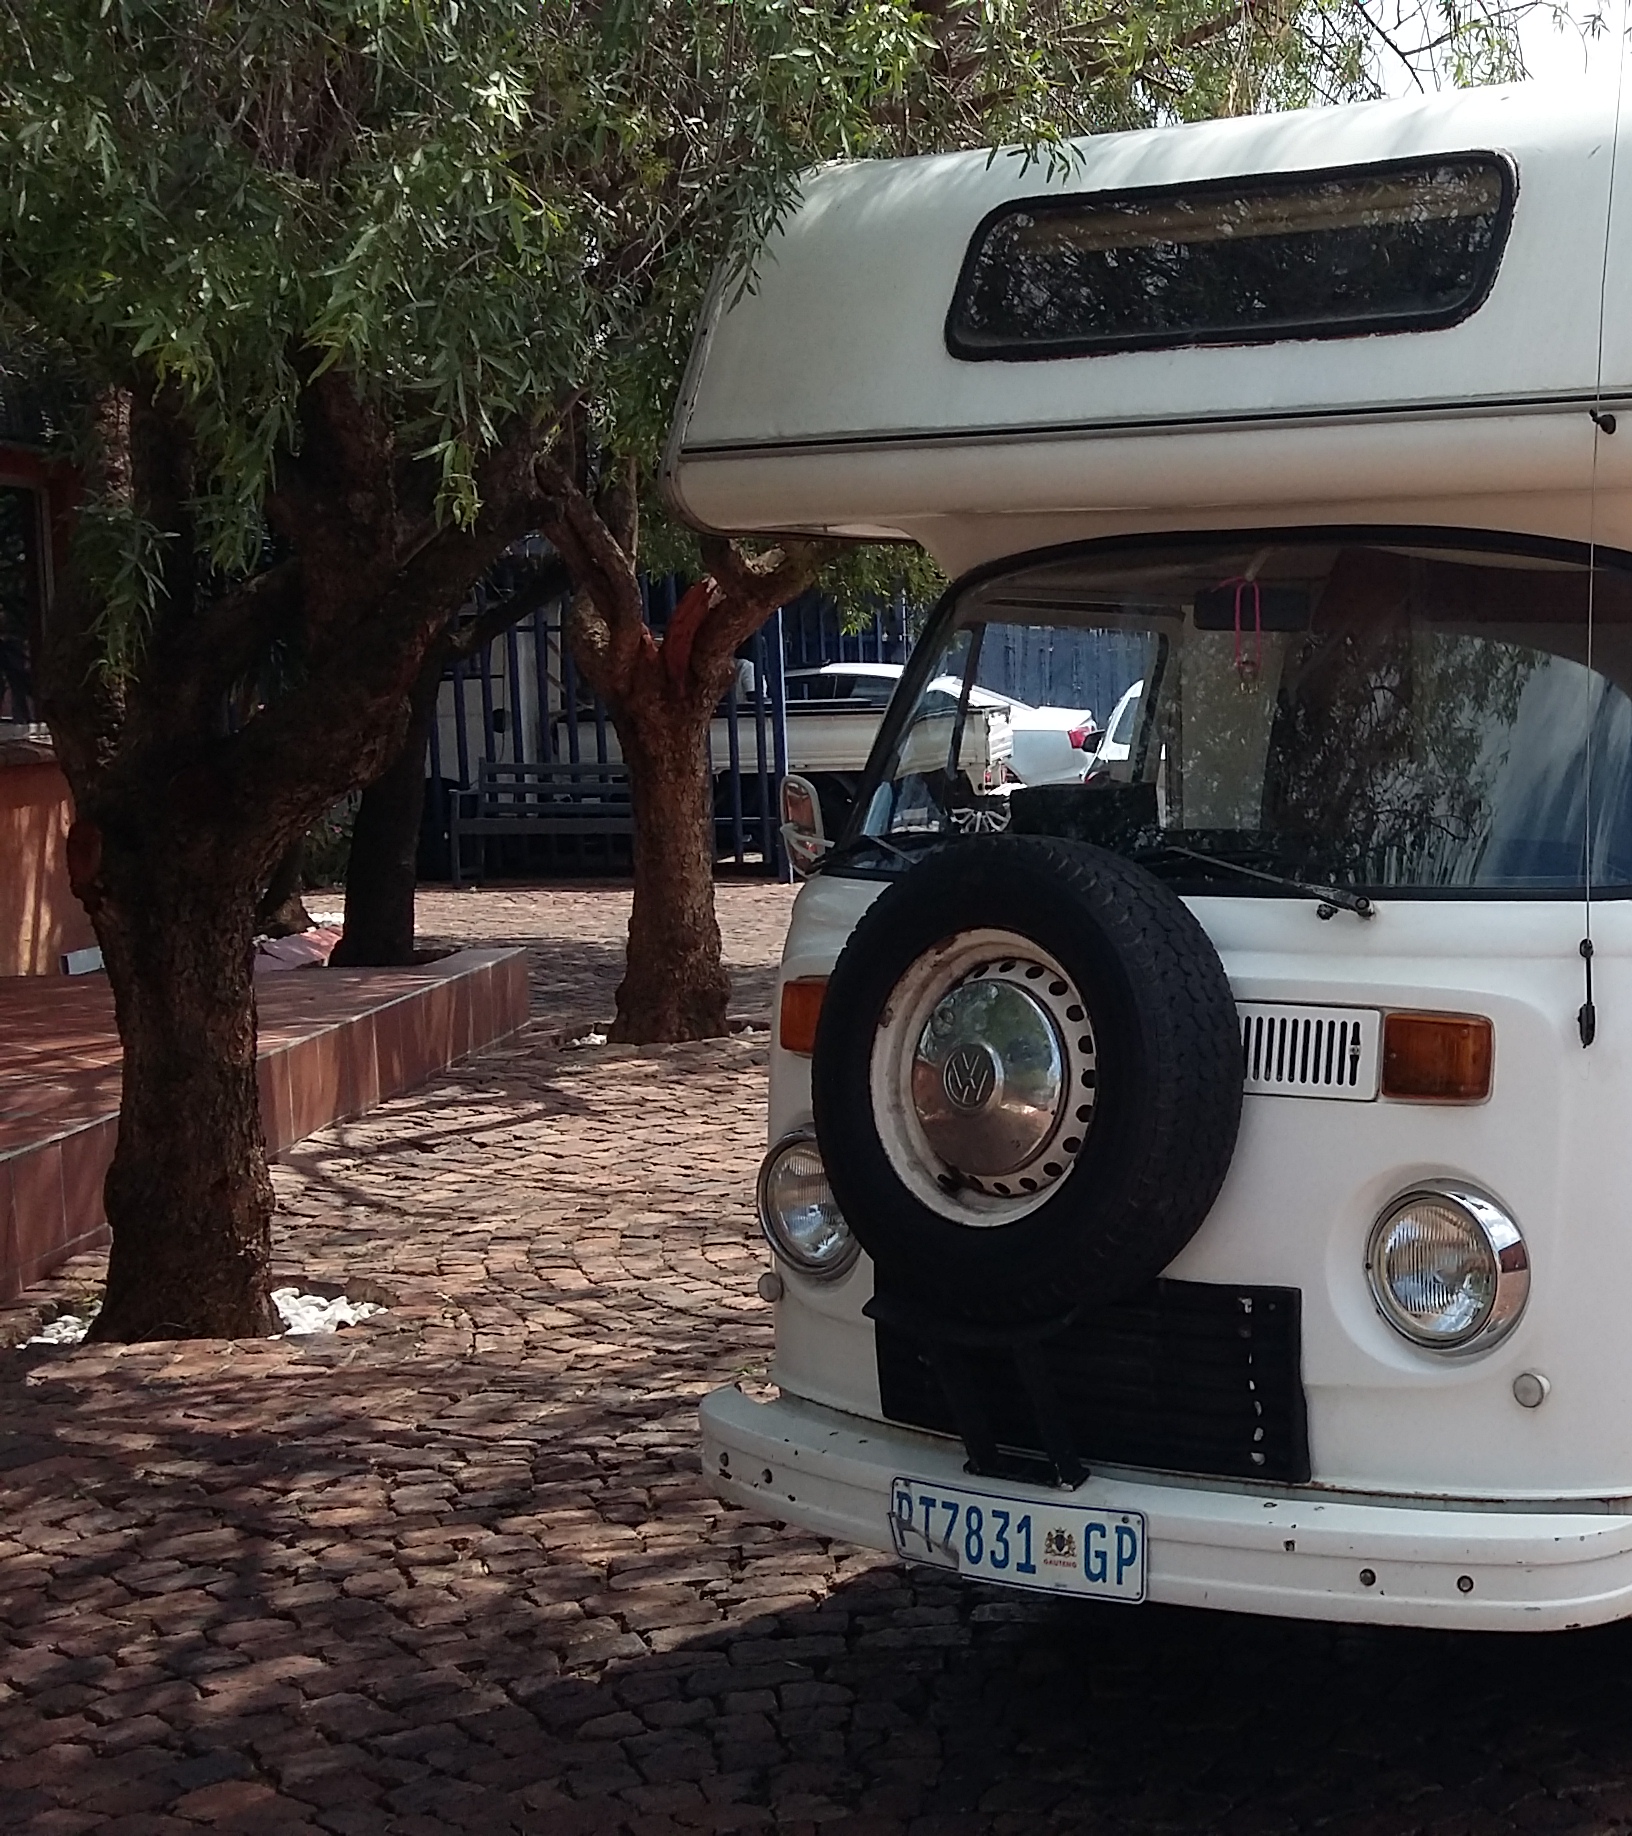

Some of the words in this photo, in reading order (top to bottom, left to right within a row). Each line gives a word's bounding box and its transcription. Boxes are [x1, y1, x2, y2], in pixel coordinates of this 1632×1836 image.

[947, 1049, 991, 1106] VW
[1043, 1558, 1077, 1568] GAUTENG
[1084, 1522, 1137, 1585] GP
